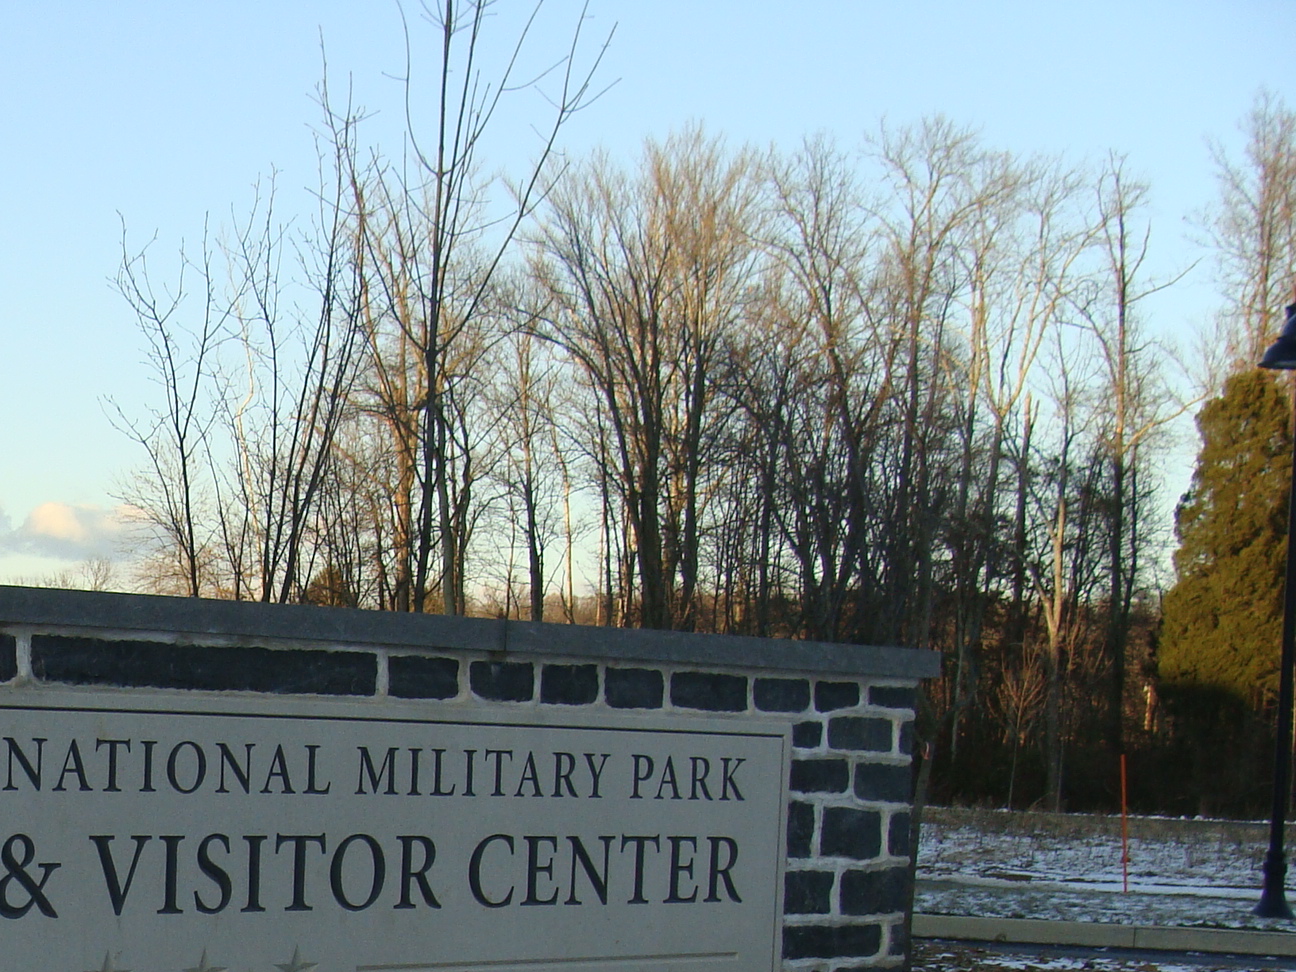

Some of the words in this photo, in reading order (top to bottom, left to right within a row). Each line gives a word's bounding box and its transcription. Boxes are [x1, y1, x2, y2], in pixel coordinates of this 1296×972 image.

[2, 736, 332, 796] NATIONAL
[354, 745, 612, 800] MILITARY
[629, 754, 746, 802] PARK
[89, 832, 442, 917] VISITOR
[468, 833, 744, 909] CENTER
